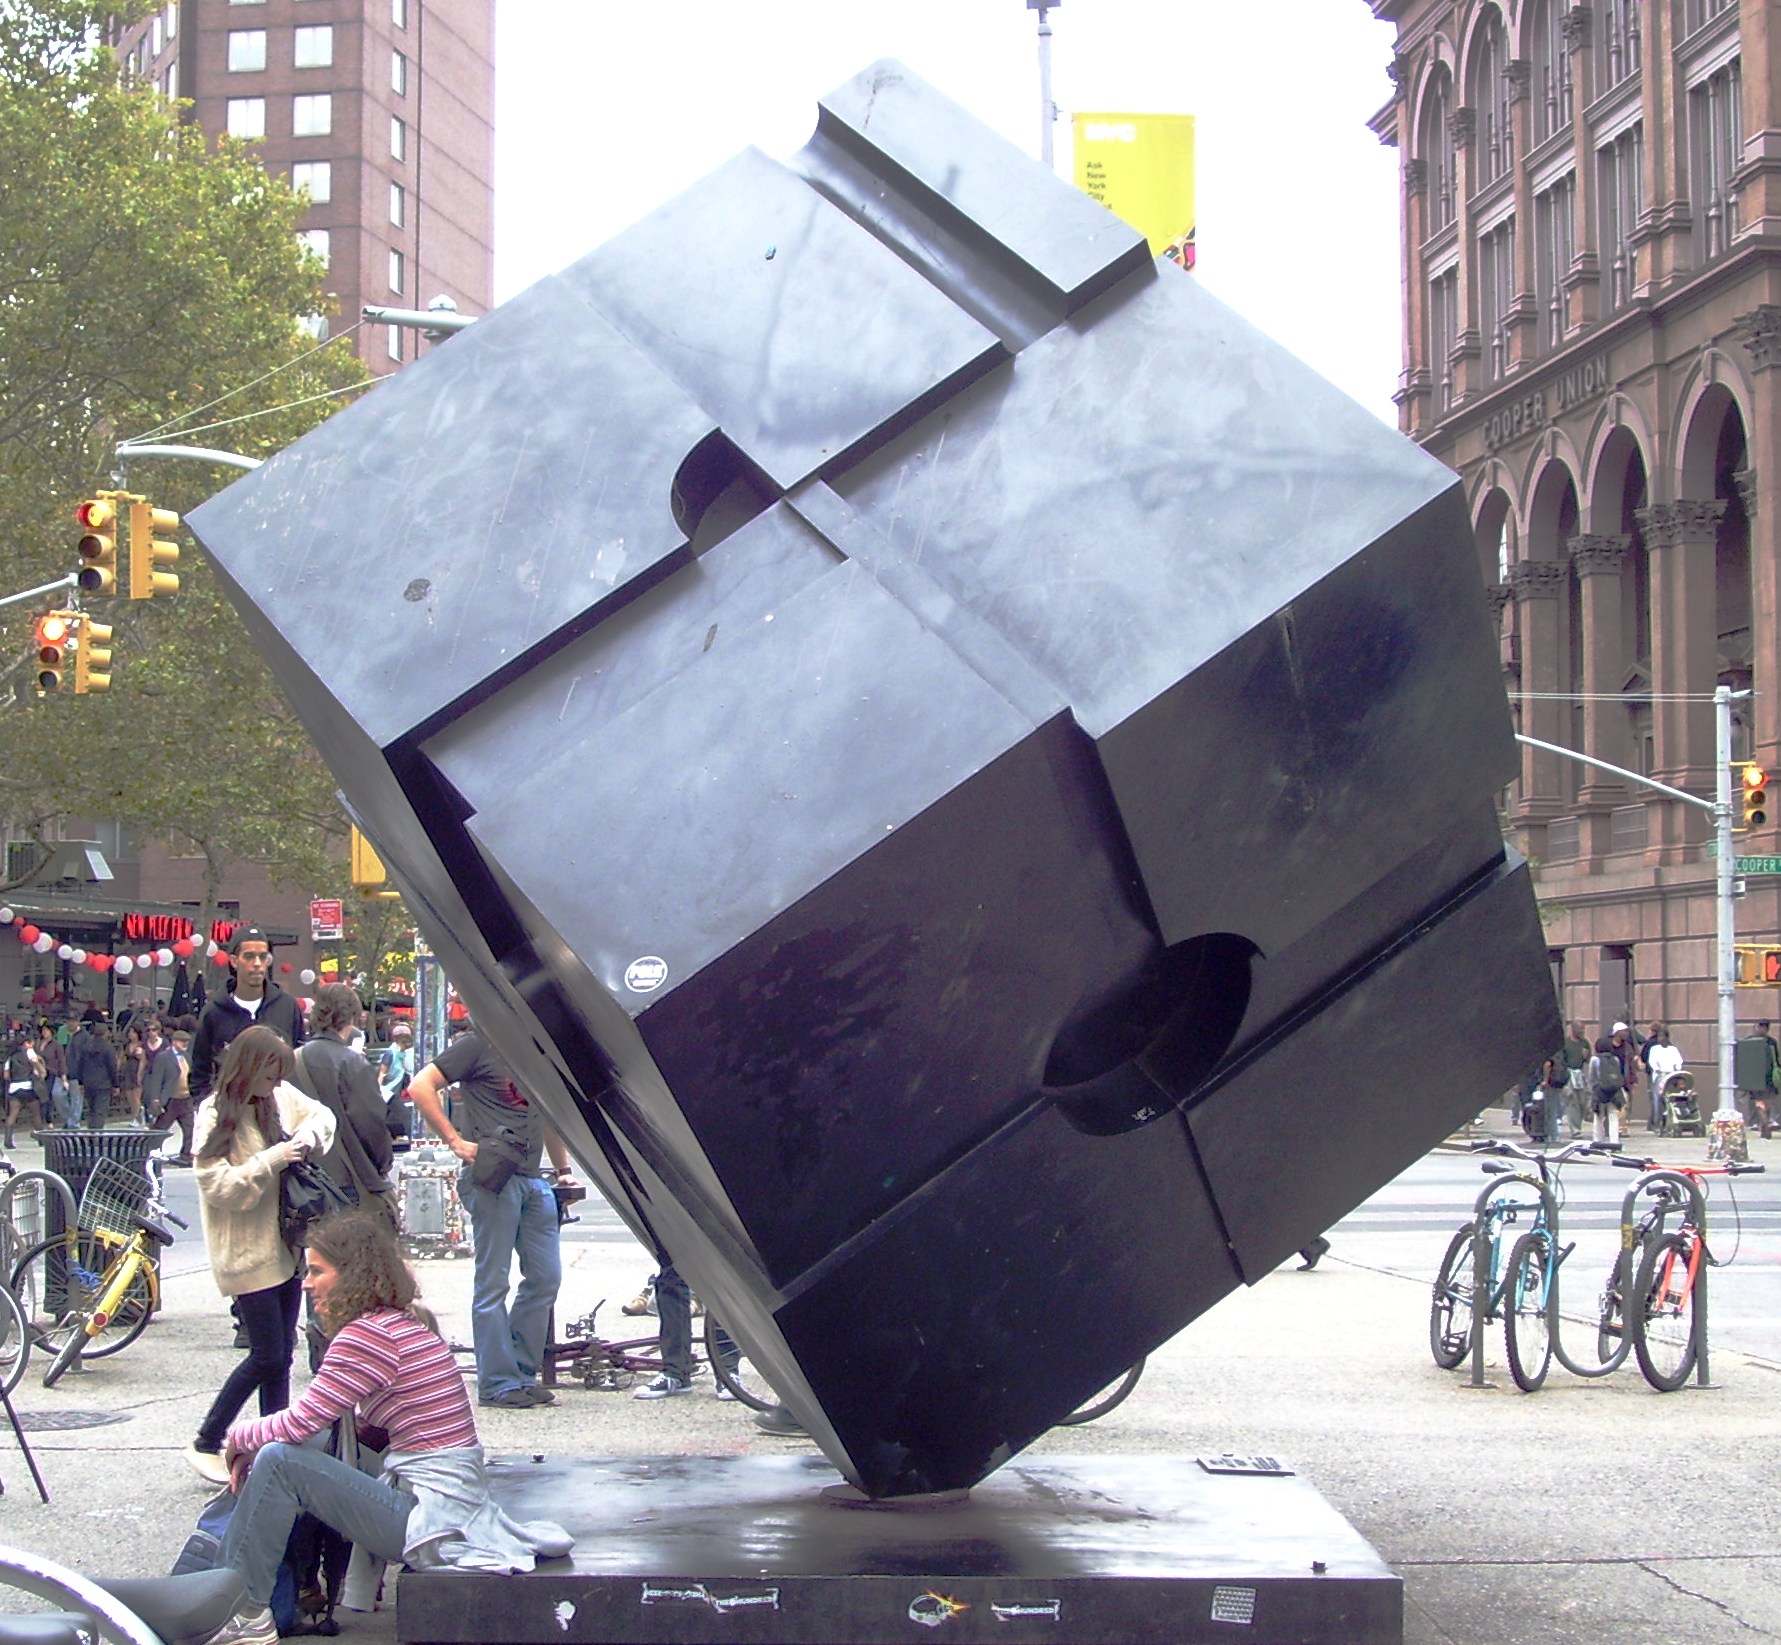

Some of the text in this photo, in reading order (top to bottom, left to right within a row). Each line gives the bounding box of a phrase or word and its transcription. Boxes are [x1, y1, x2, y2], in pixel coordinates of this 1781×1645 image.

[1087, 161, 1102, 169] Ask
[1087, 171, 1106, 179] New
[1087, 181, 1106, 189] York
[1483, 354, 1607, 444] COOPER UNION
[1735, 858, 1776, 872] COOPER
